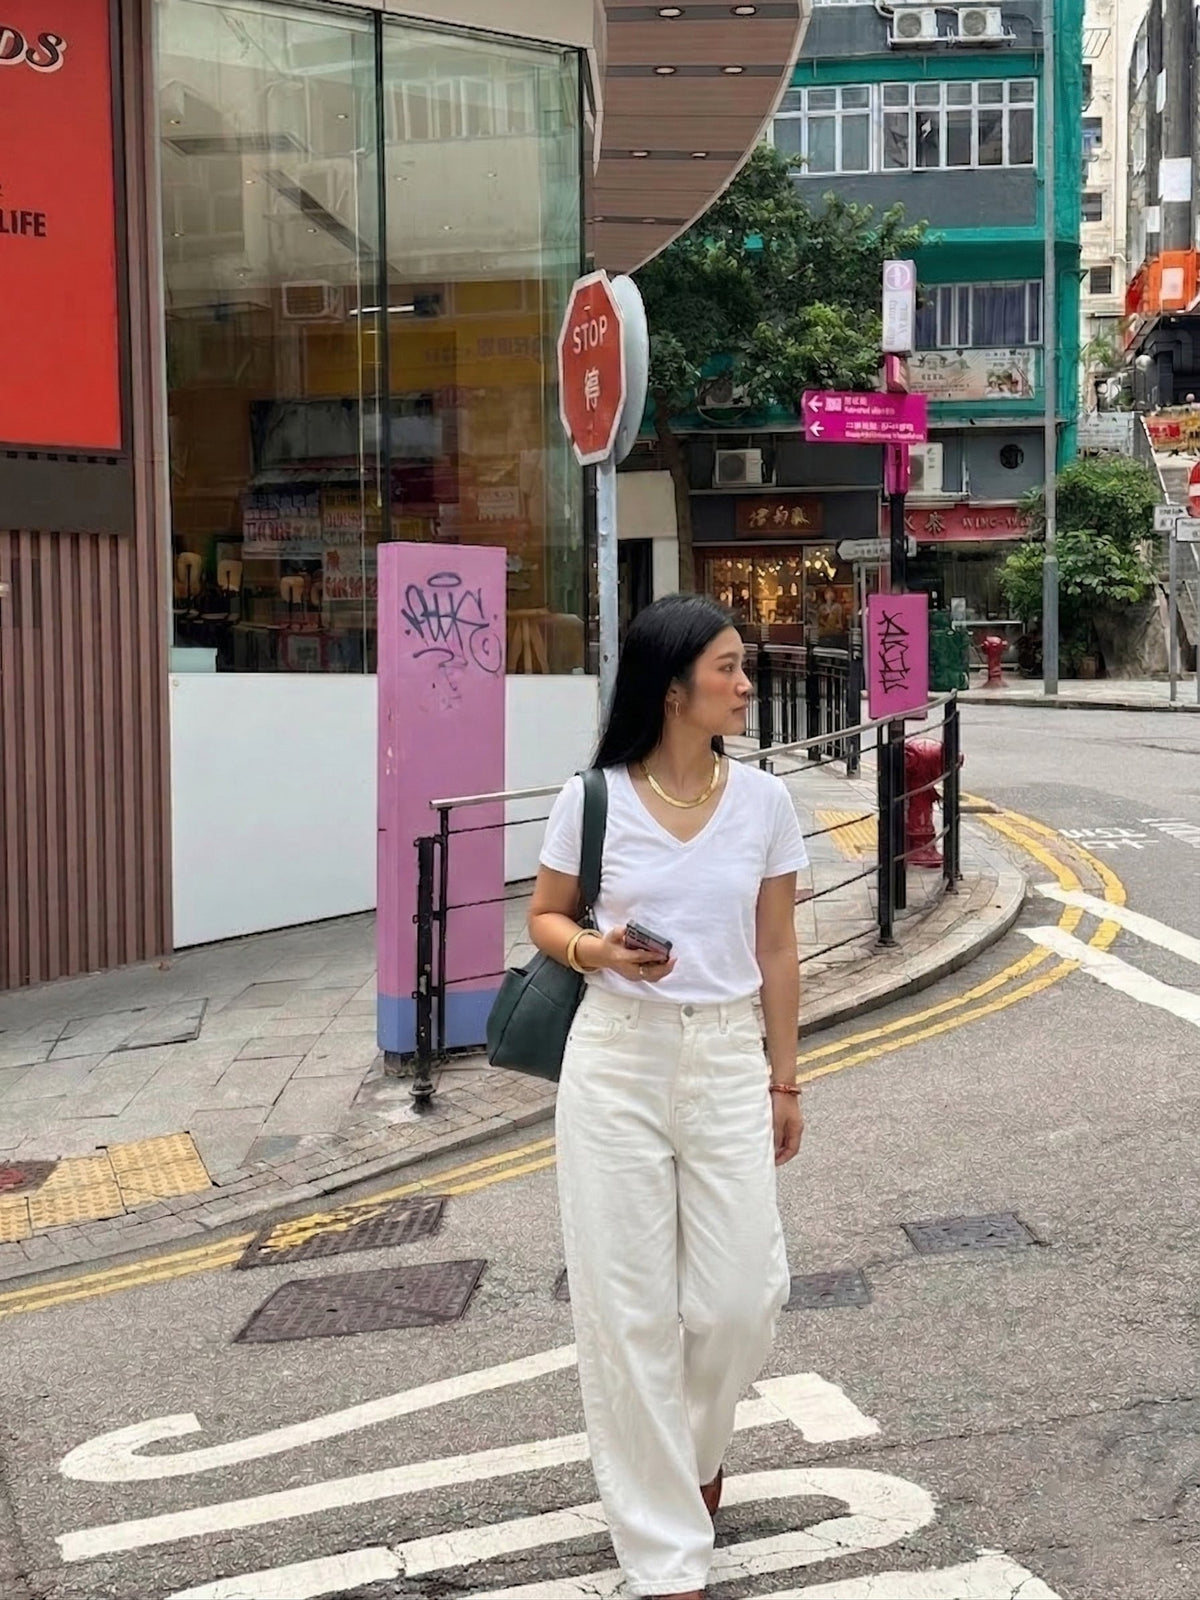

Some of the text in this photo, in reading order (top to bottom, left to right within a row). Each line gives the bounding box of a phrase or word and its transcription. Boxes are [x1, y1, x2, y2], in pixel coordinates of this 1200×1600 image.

[0, 208, 47, 238] LIFE
[572, 314, 608, 355] STOP
[584, 367, 600, 412] 停
